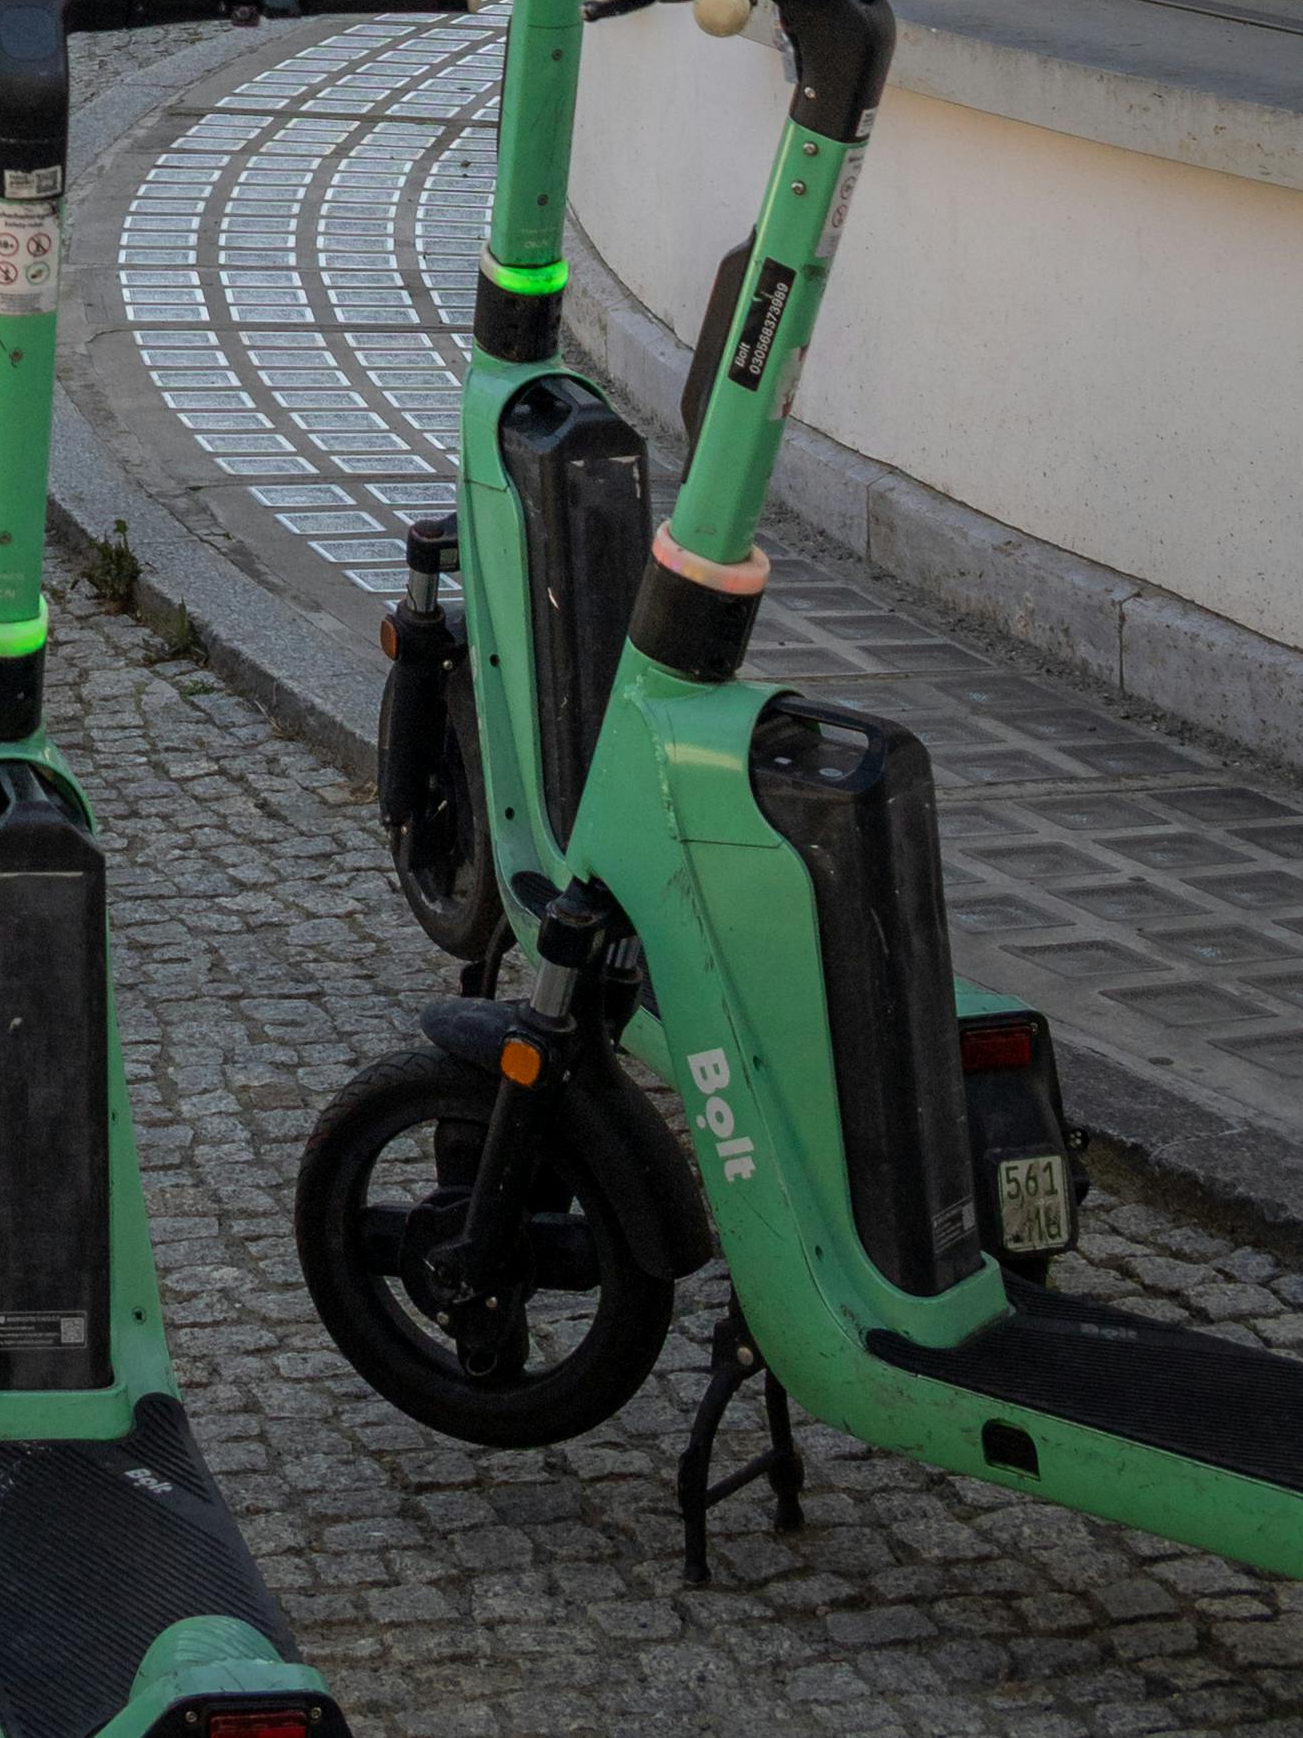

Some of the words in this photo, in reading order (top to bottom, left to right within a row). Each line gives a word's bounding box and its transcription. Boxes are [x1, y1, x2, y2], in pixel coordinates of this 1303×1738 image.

[735, 342, 751, 367] Bolt
[686, 1047, 758, 1184] Bolt
[1005, 1161, 1059, 1200] 561
[124, 1468, 173, 1494] Bolt
